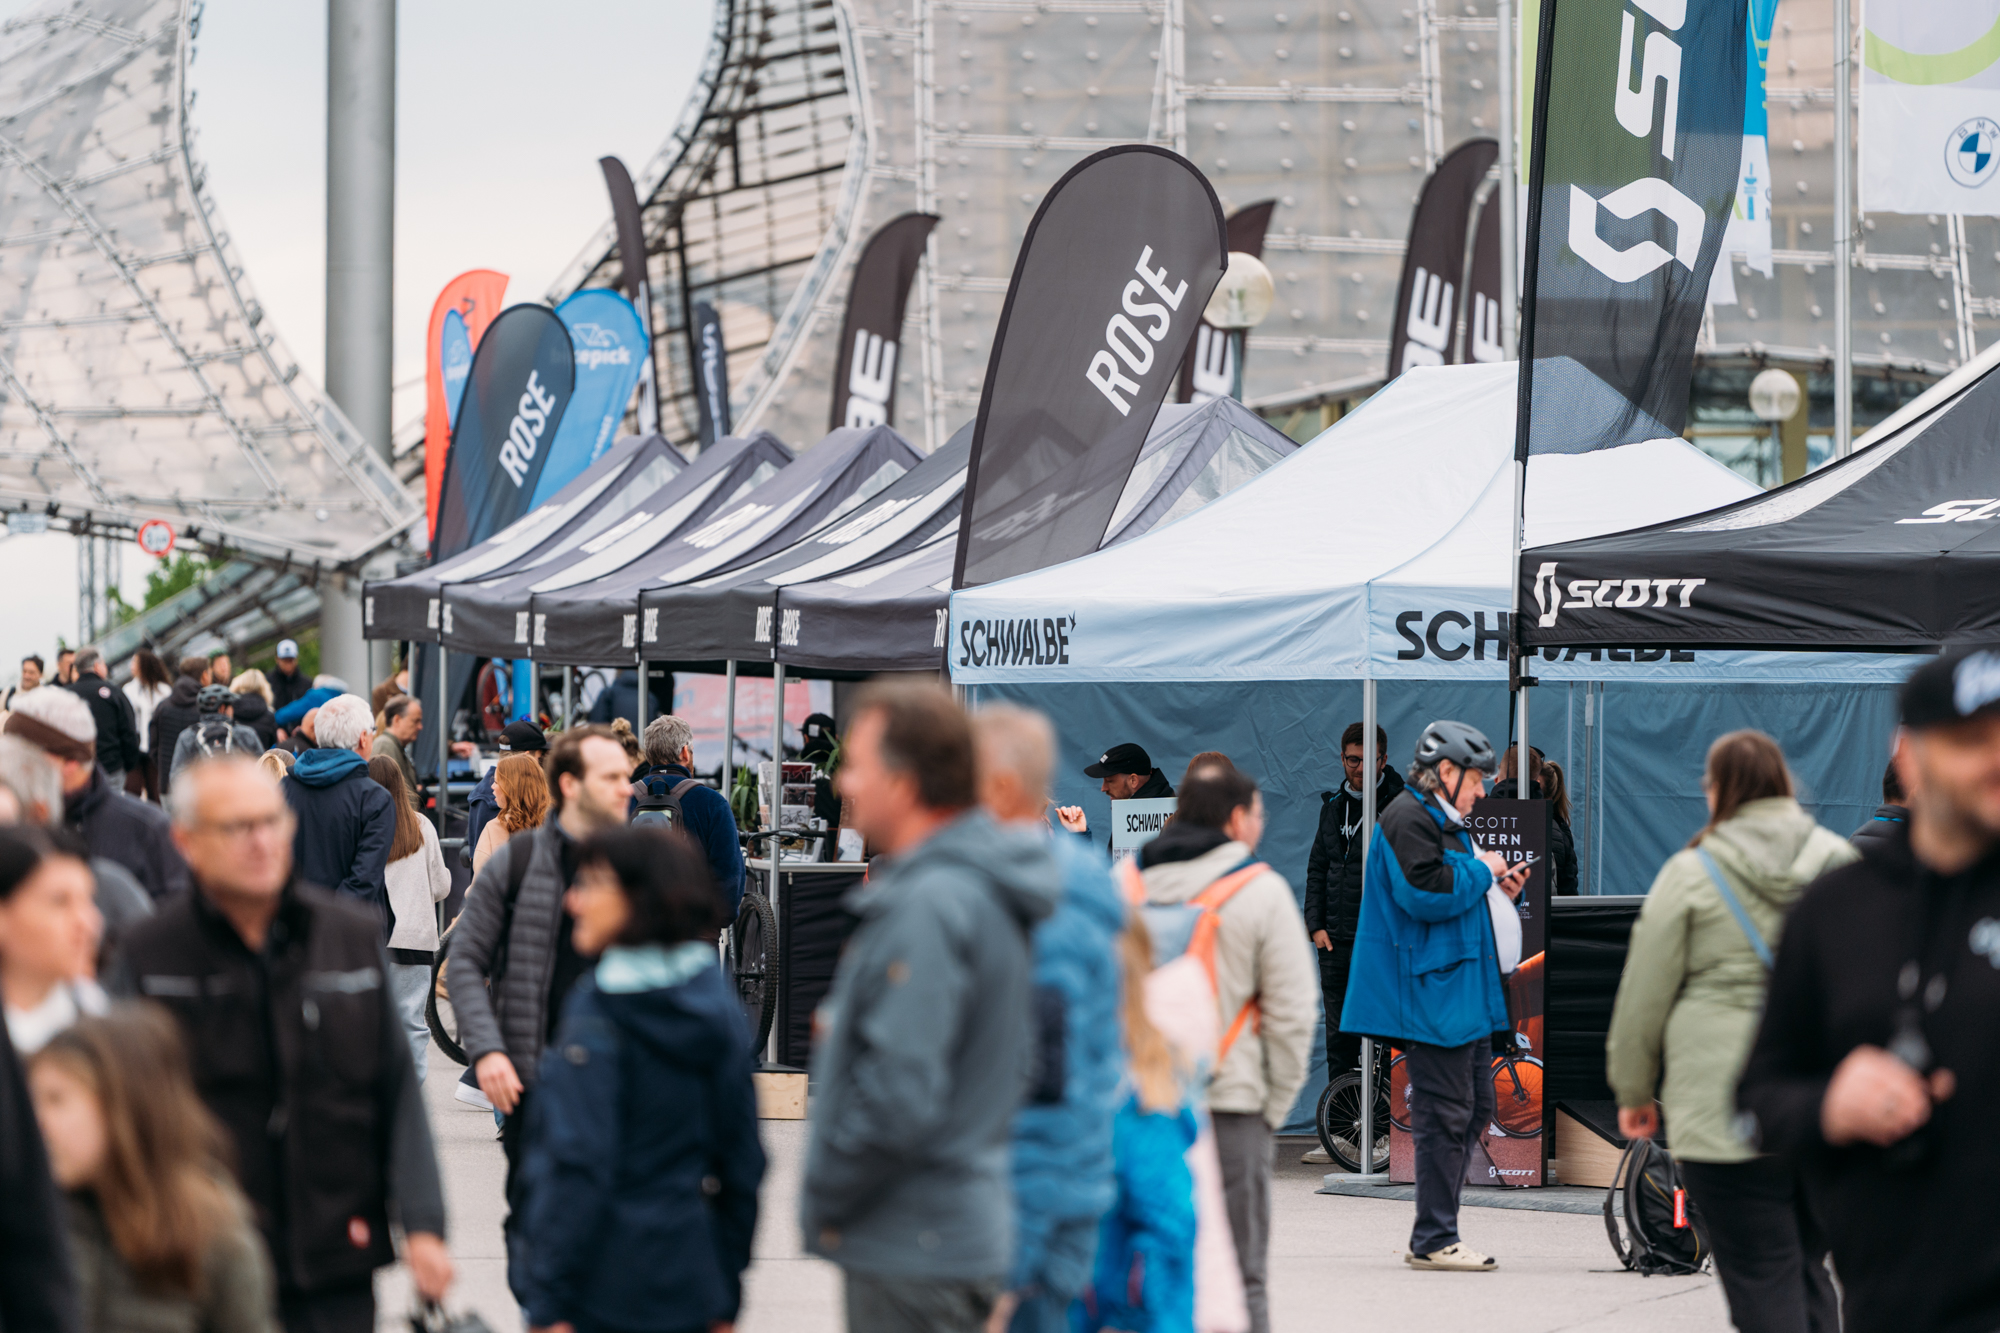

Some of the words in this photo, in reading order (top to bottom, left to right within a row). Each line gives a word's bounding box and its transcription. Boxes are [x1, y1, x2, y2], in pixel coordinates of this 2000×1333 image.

[1086, 245, 1188, 417] ROSE
[498, 369, 556, 488] ROSE
[1893, 498, 2000, 524] SC
[1562, 579, 1706, 608] SCOTT
[780, 609, 800, 646] ROSE
[933, 608, 948, 647] RO
[960, 618, 1069, 667] SCHWALBE
[1464, 816, 1518, 828] SCOTT
[1476, 833, 1521, 845] YERN
